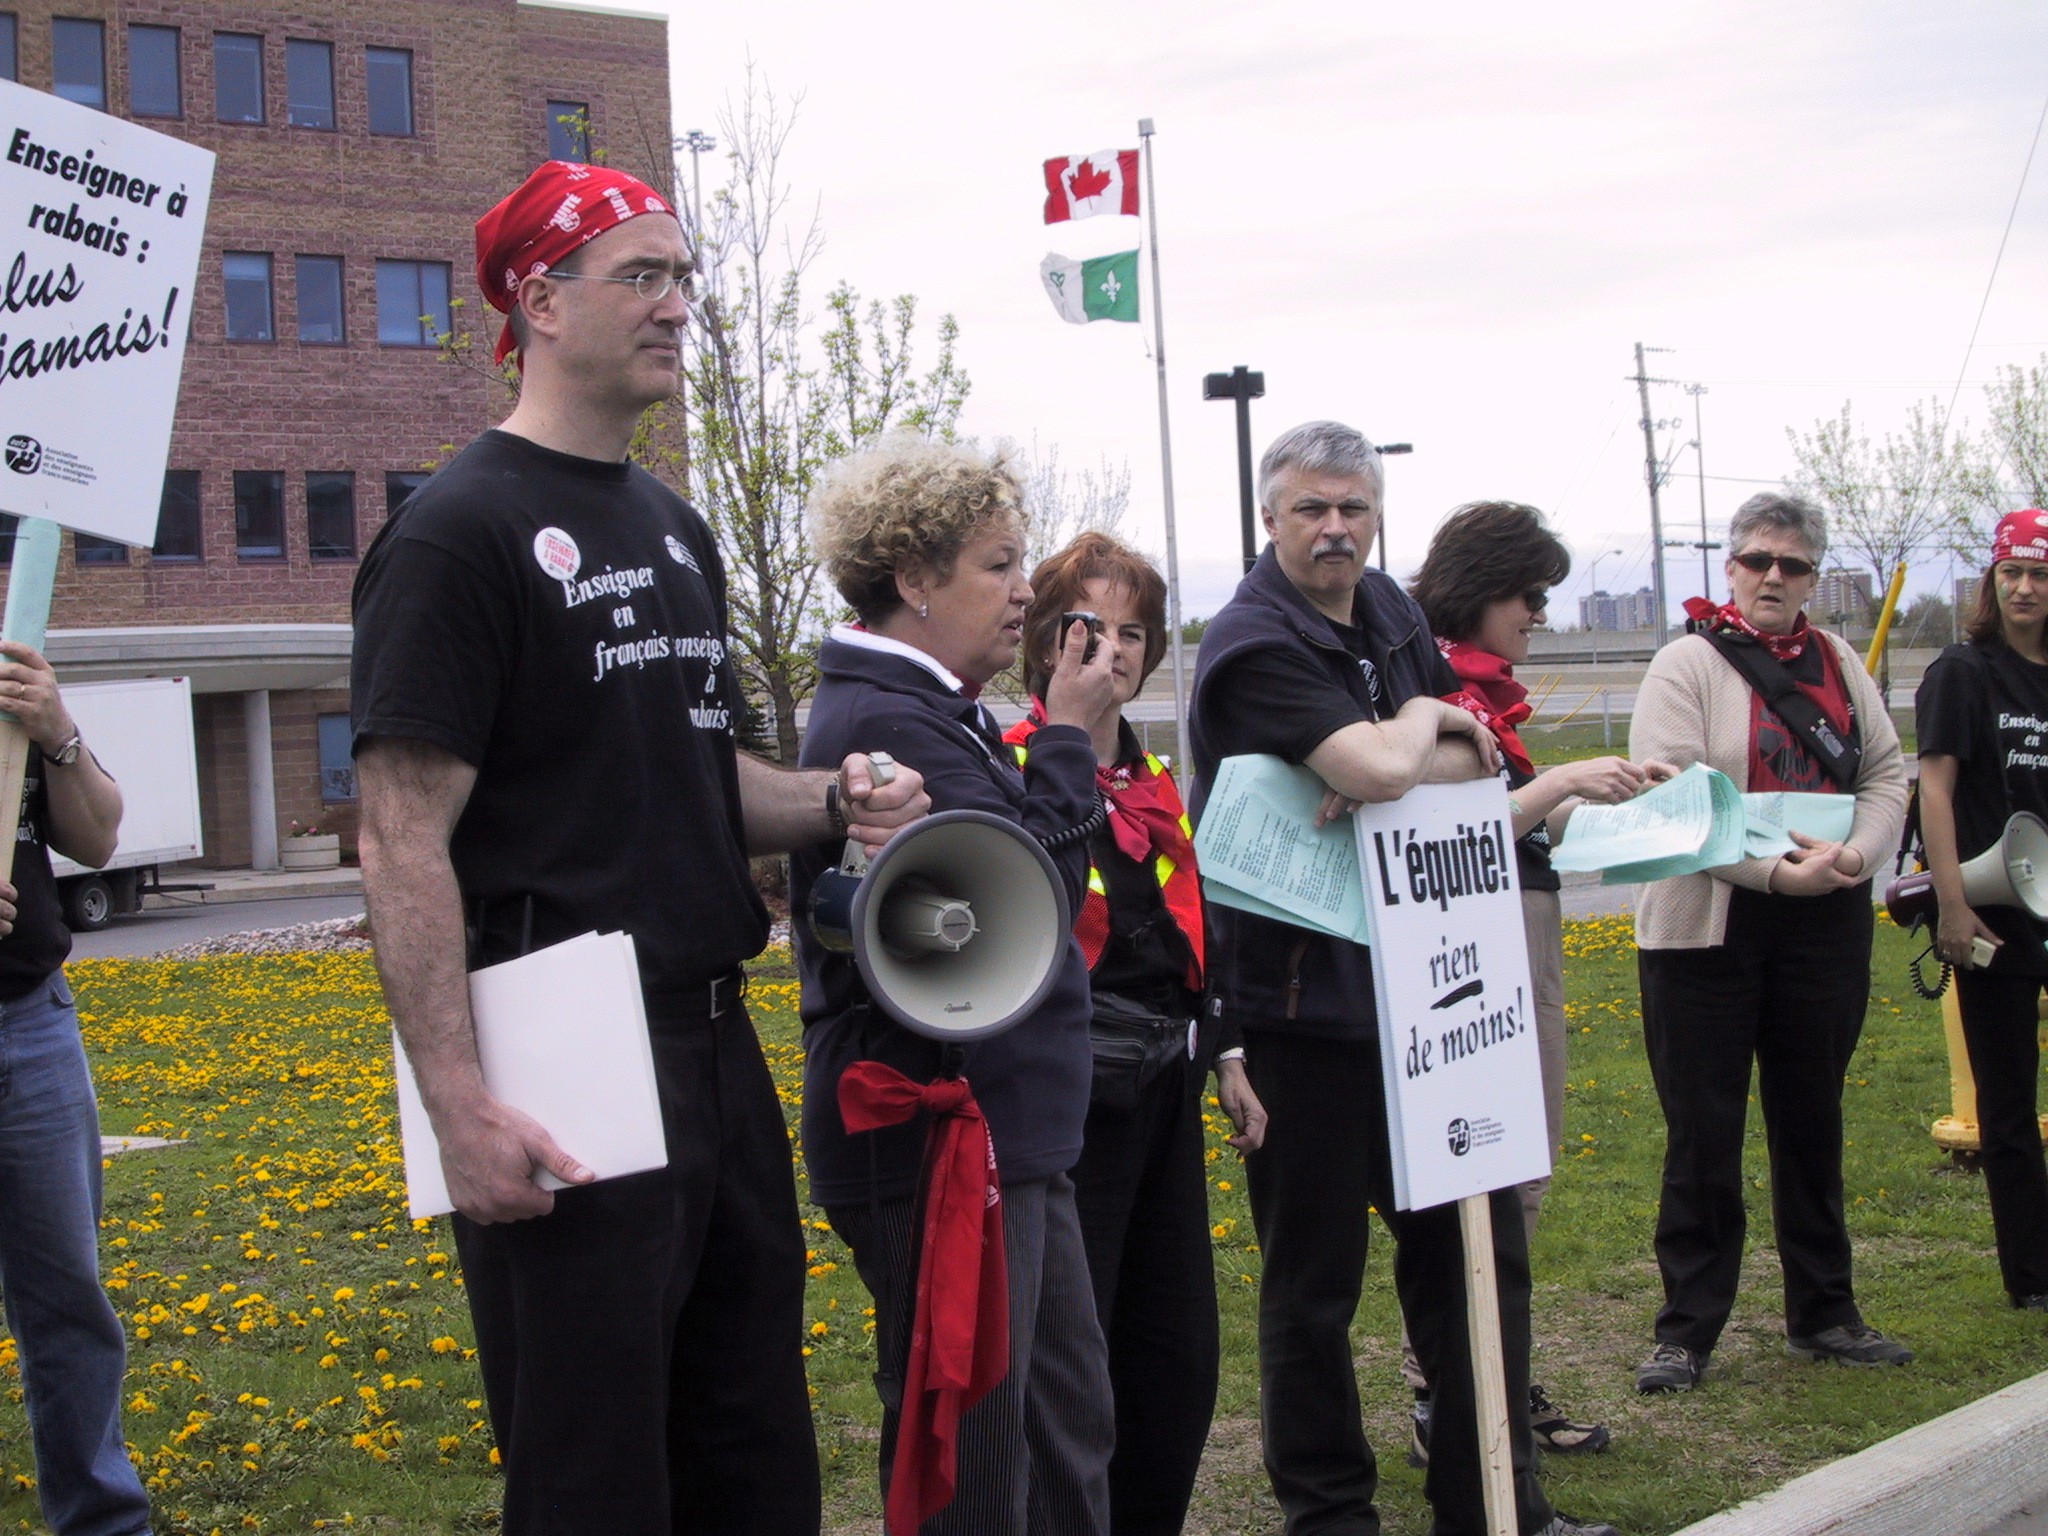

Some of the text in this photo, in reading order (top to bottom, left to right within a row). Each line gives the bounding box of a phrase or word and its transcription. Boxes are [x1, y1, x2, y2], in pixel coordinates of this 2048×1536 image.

[7, 128, 188, 218] Enseigner à
[0, 251, 85, 313] lus
[562, 565, 655, 608] Enseigner
[613, 605, 636, 629] en
[593, 629, 670, 682] français
[704, 664, 716, 694] à
[2024, 735, 2040, 747] en
[1374, 820, 1510, 912] L'équité!
[1429, 935, 1480, 988] rien
[1406, 986, 1524, 1080] de moins!
